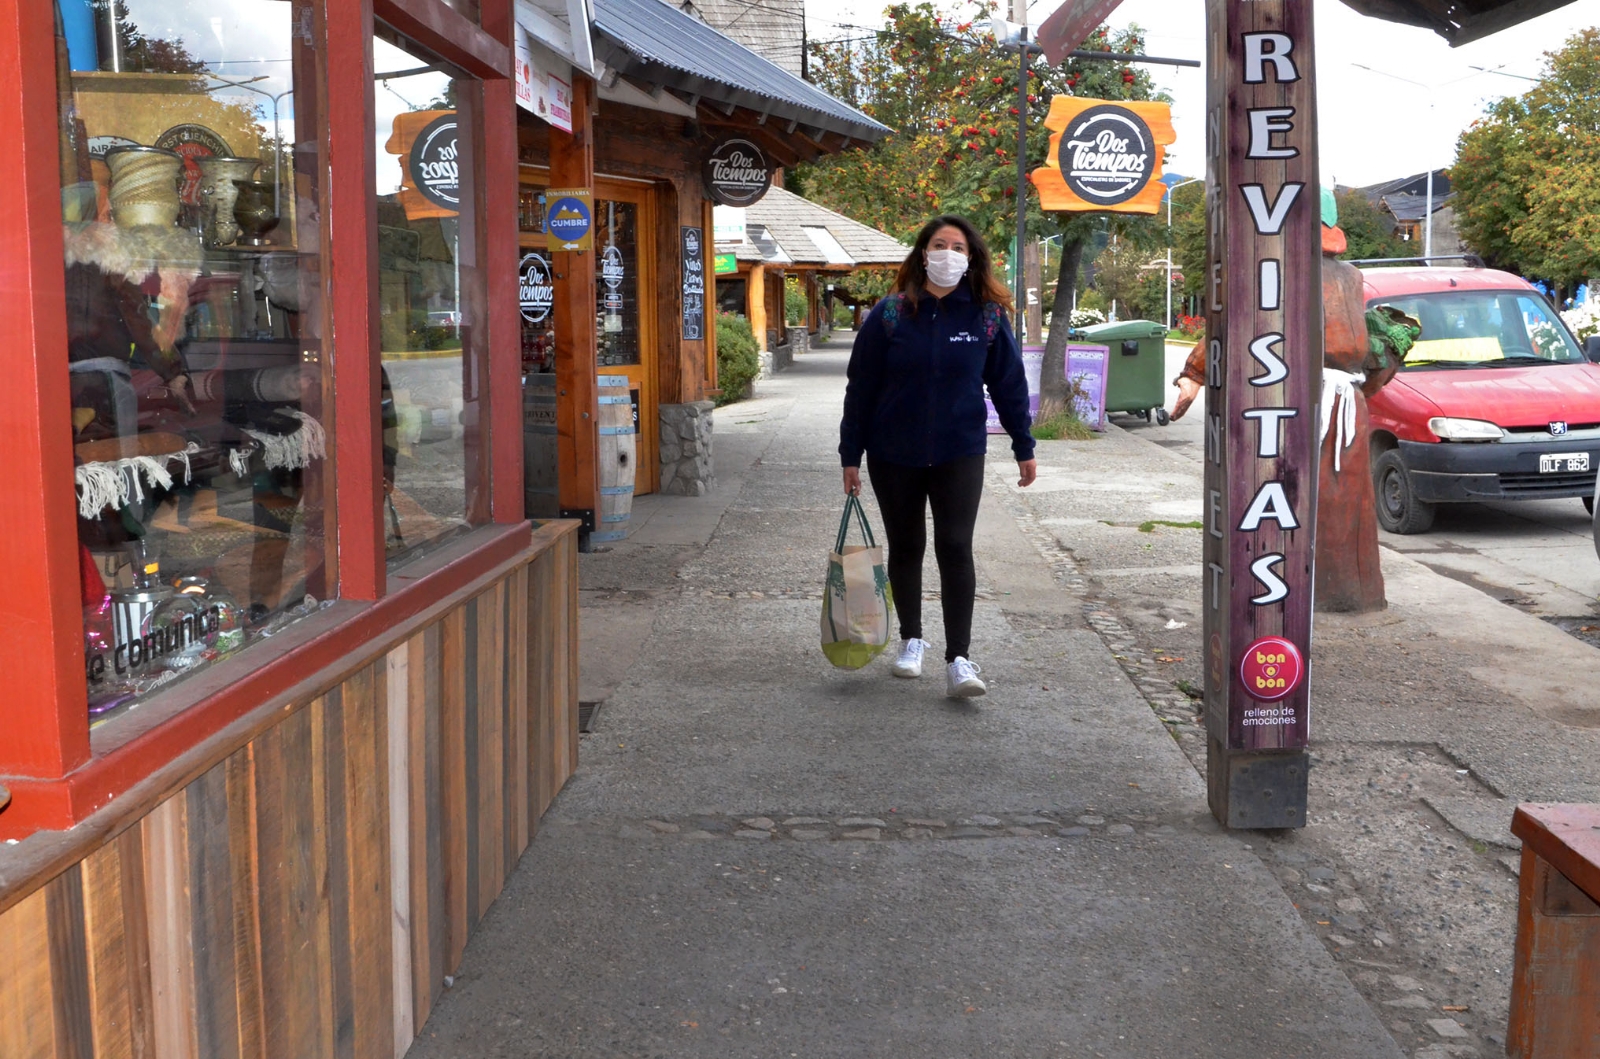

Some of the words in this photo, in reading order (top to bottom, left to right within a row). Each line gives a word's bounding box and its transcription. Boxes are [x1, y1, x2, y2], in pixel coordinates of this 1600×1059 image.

[1095, 130, 1130, 153] Dos
[730, 151, 753, 168] Dos
[1067, 140, 1148, 178] Tiempos
[709, 158, 767, 186] Tiempos
[551, 219, 588, 227] CUMBRE
[527, 266, 544, 285] Dos
[1238, 31, 1305, 606] REVISTAS
[1542, 459, 1562, 472] DLF
[1567, 458, 1588, 471] 862
[114, 604, 219, 675] comunica
[1256, 651, 1286, 664] bon
[1266, 666, 1276, 676] o
[1256, 676, 1286, 689] bon
[1244, 707, 1279, 717] relleno
[1281, 706, 1295, 715] de
[1242, 716, 1297, 726] emociones
